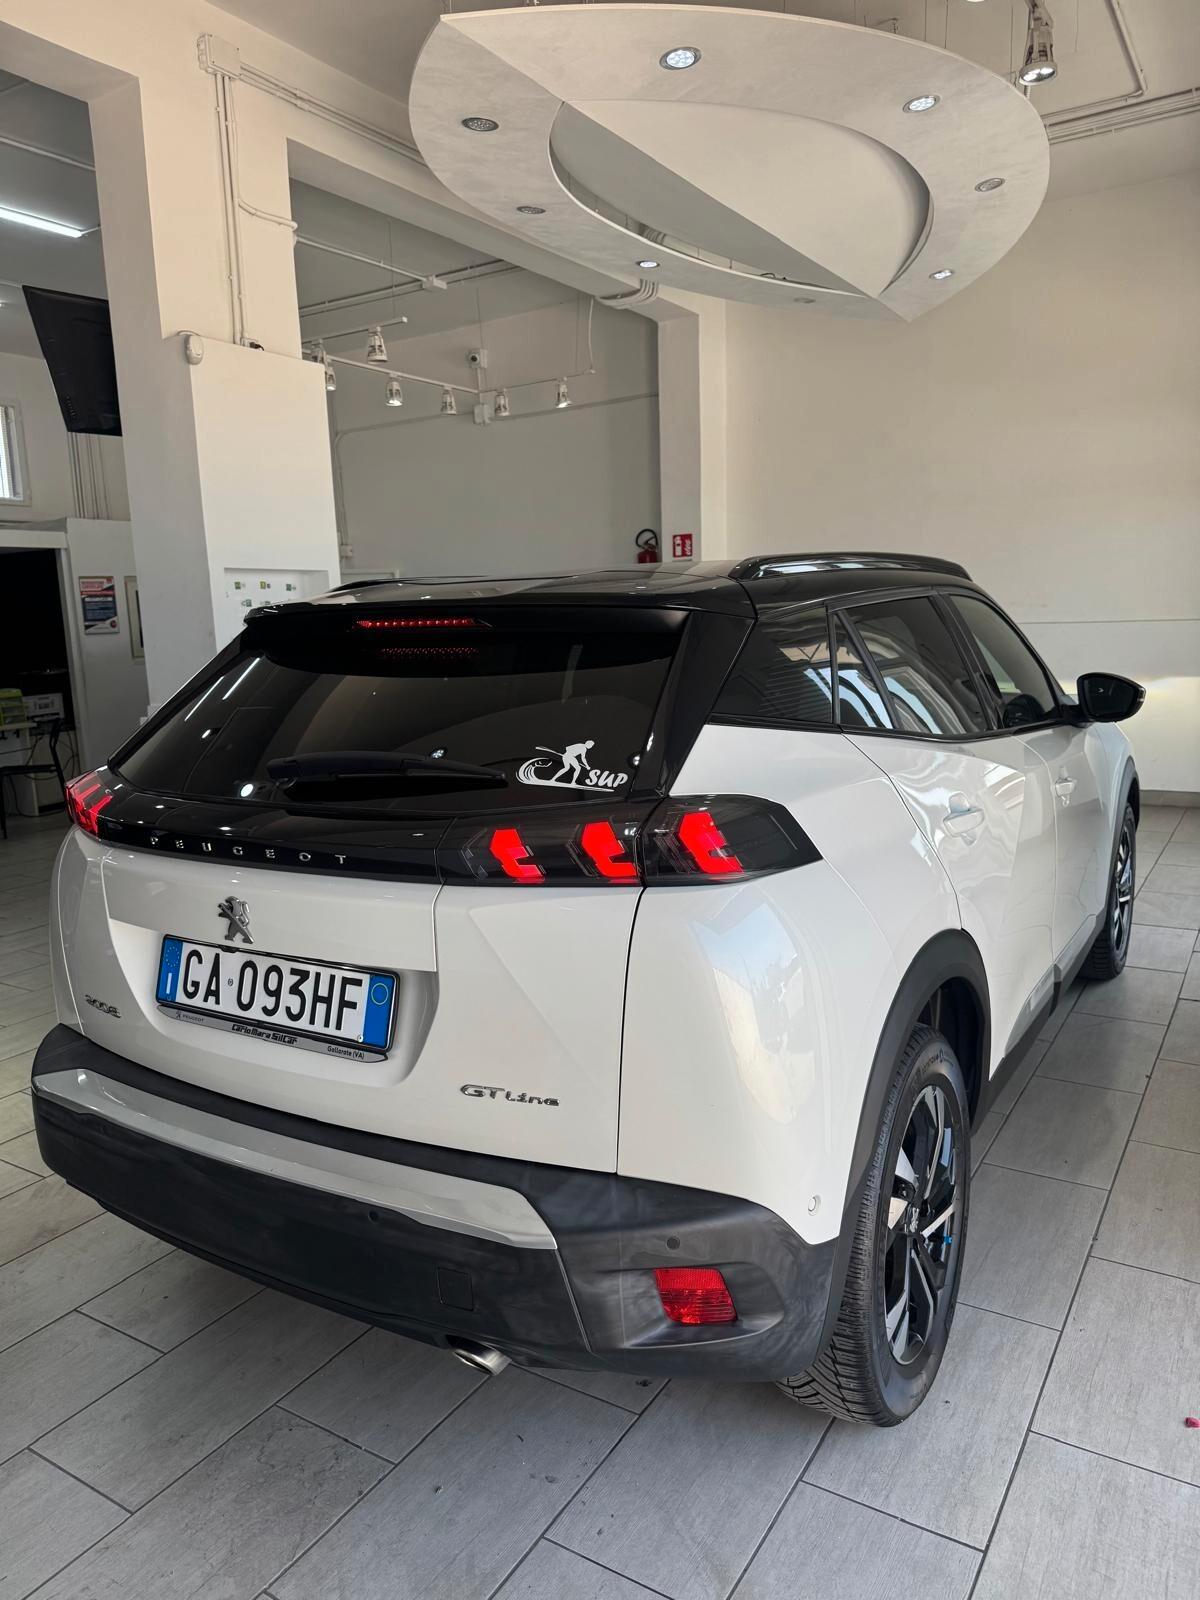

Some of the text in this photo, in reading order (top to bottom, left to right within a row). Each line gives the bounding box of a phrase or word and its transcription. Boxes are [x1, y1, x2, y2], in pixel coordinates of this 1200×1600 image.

[585, 769, 628, 788] SUP
[150, 837, 347, 864] PEUGEOT
[183, 949, 363, 1031] GA 093HF
[352, 1050, 365, 1060] (VA)
